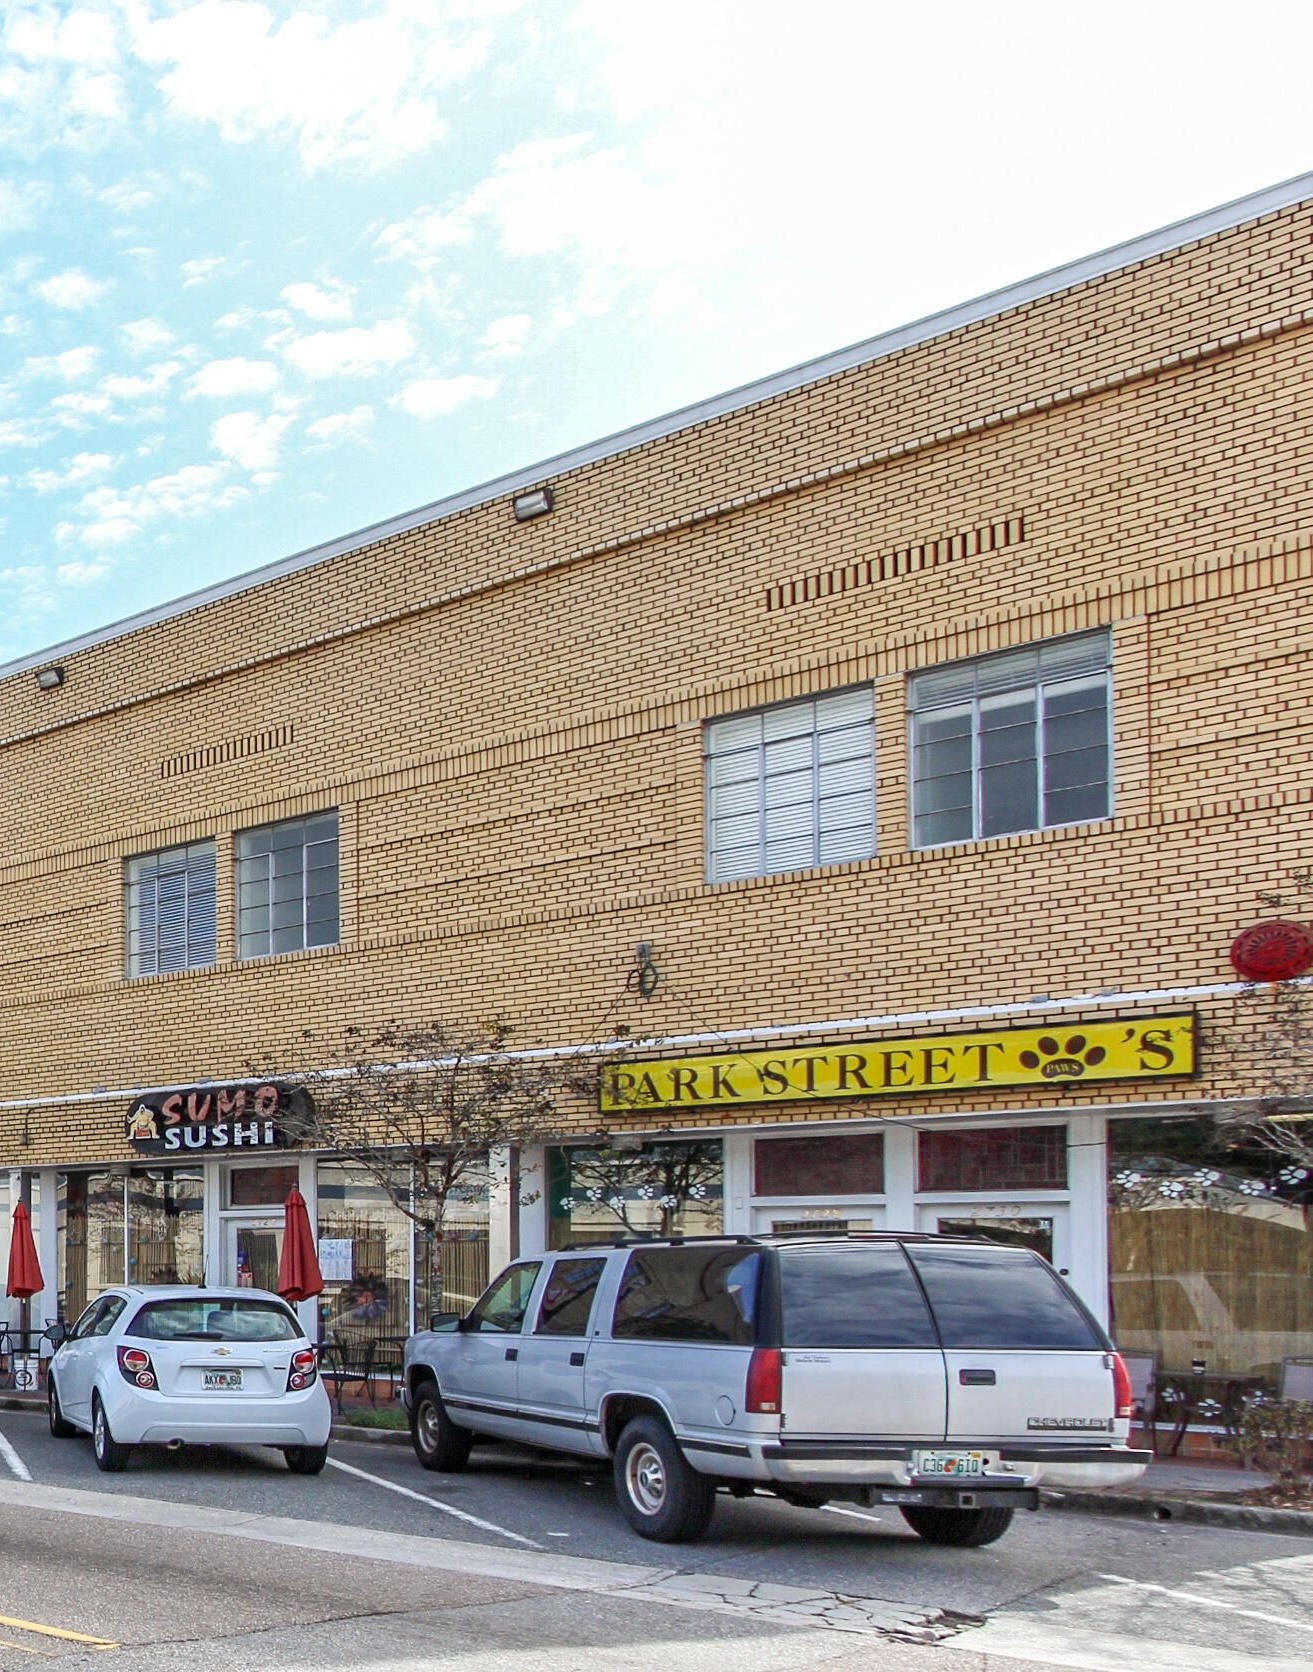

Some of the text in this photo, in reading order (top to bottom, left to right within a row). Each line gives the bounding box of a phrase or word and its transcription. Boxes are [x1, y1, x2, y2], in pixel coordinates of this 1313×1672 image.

[610, 1063, 742, 1107] PARK
[762, 1042, 1005, 1096] STREET
[1046, 1062, 1080, 1074] PAWS
[161, 1085, 279, 1125] SUMO
[165, 1121, 274, 1150] SUSHI
[1027, 1416, 1108, 1430] CHEVROLET
[923, 1458, 943, 1473] C36
